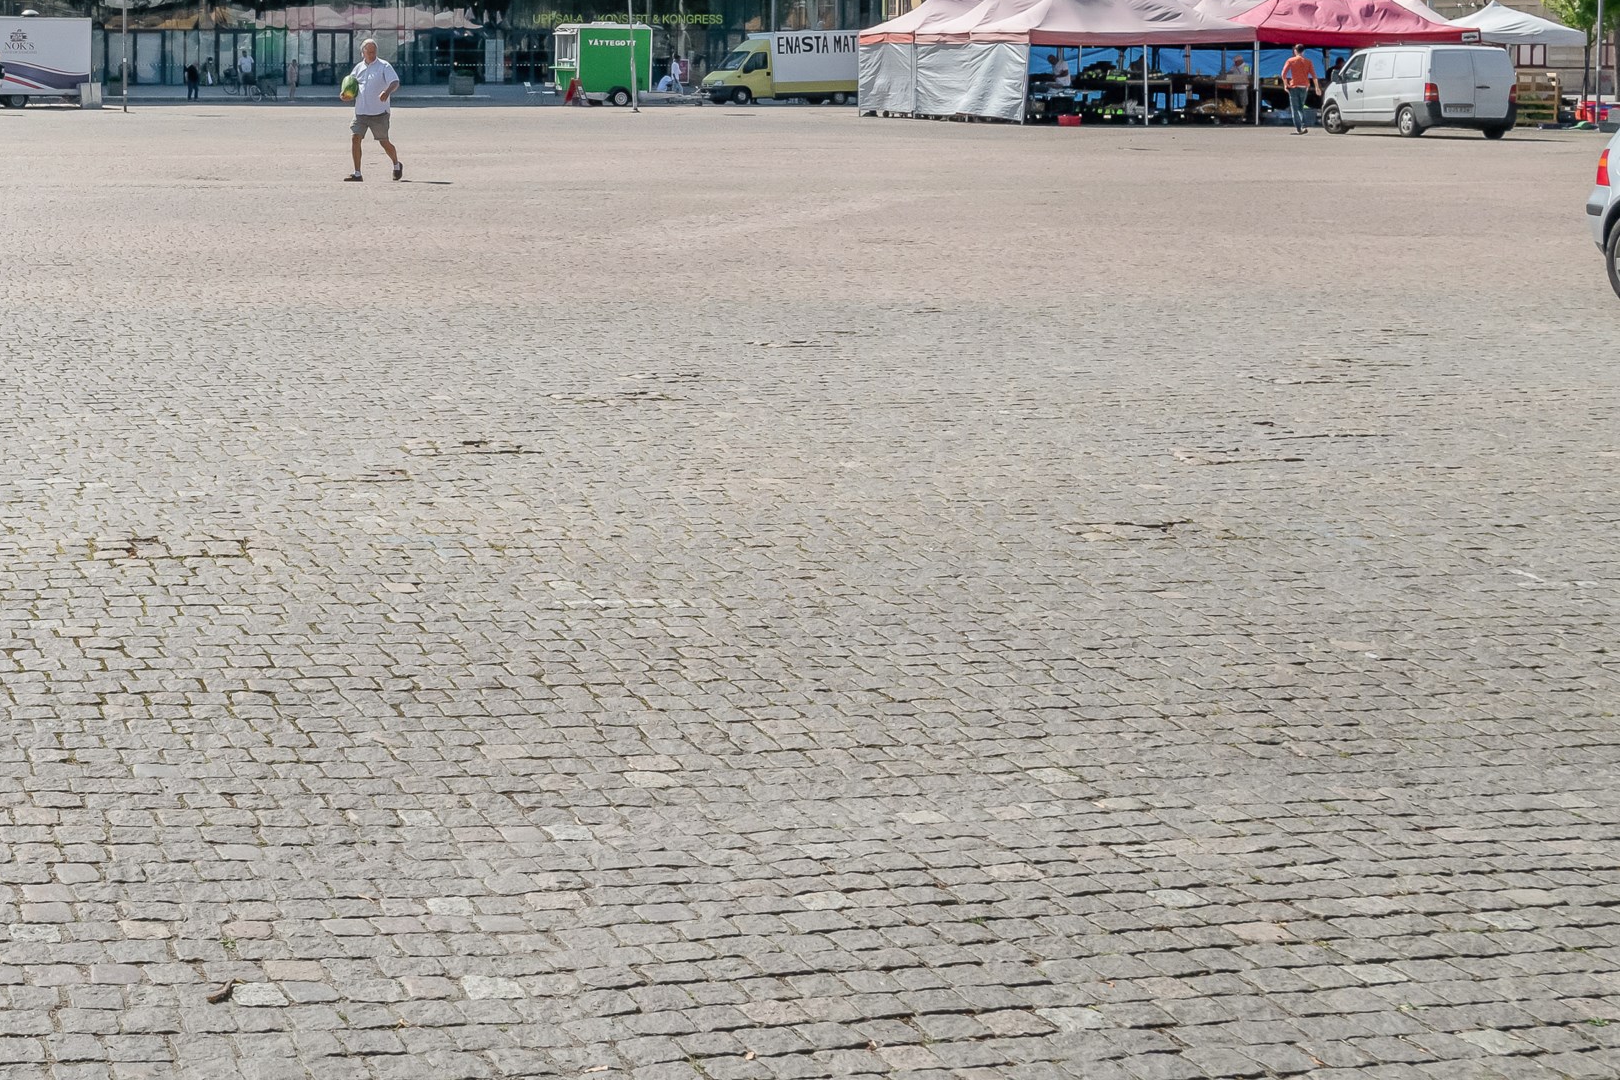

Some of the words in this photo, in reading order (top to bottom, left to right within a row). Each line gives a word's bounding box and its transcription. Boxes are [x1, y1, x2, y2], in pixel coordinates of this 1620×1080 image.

[533, 14, 583, 24] UPPSALA
[598, 14, 648, 24] KONSERT
[653, 15, 659, 24] &
[662, 14, 723, 24] KONGRESS
[5, 42, 35, 50] NOK'S
[777, 33, 829, 54] ENASTÅ
[834, 35, 857, 53] MAT
